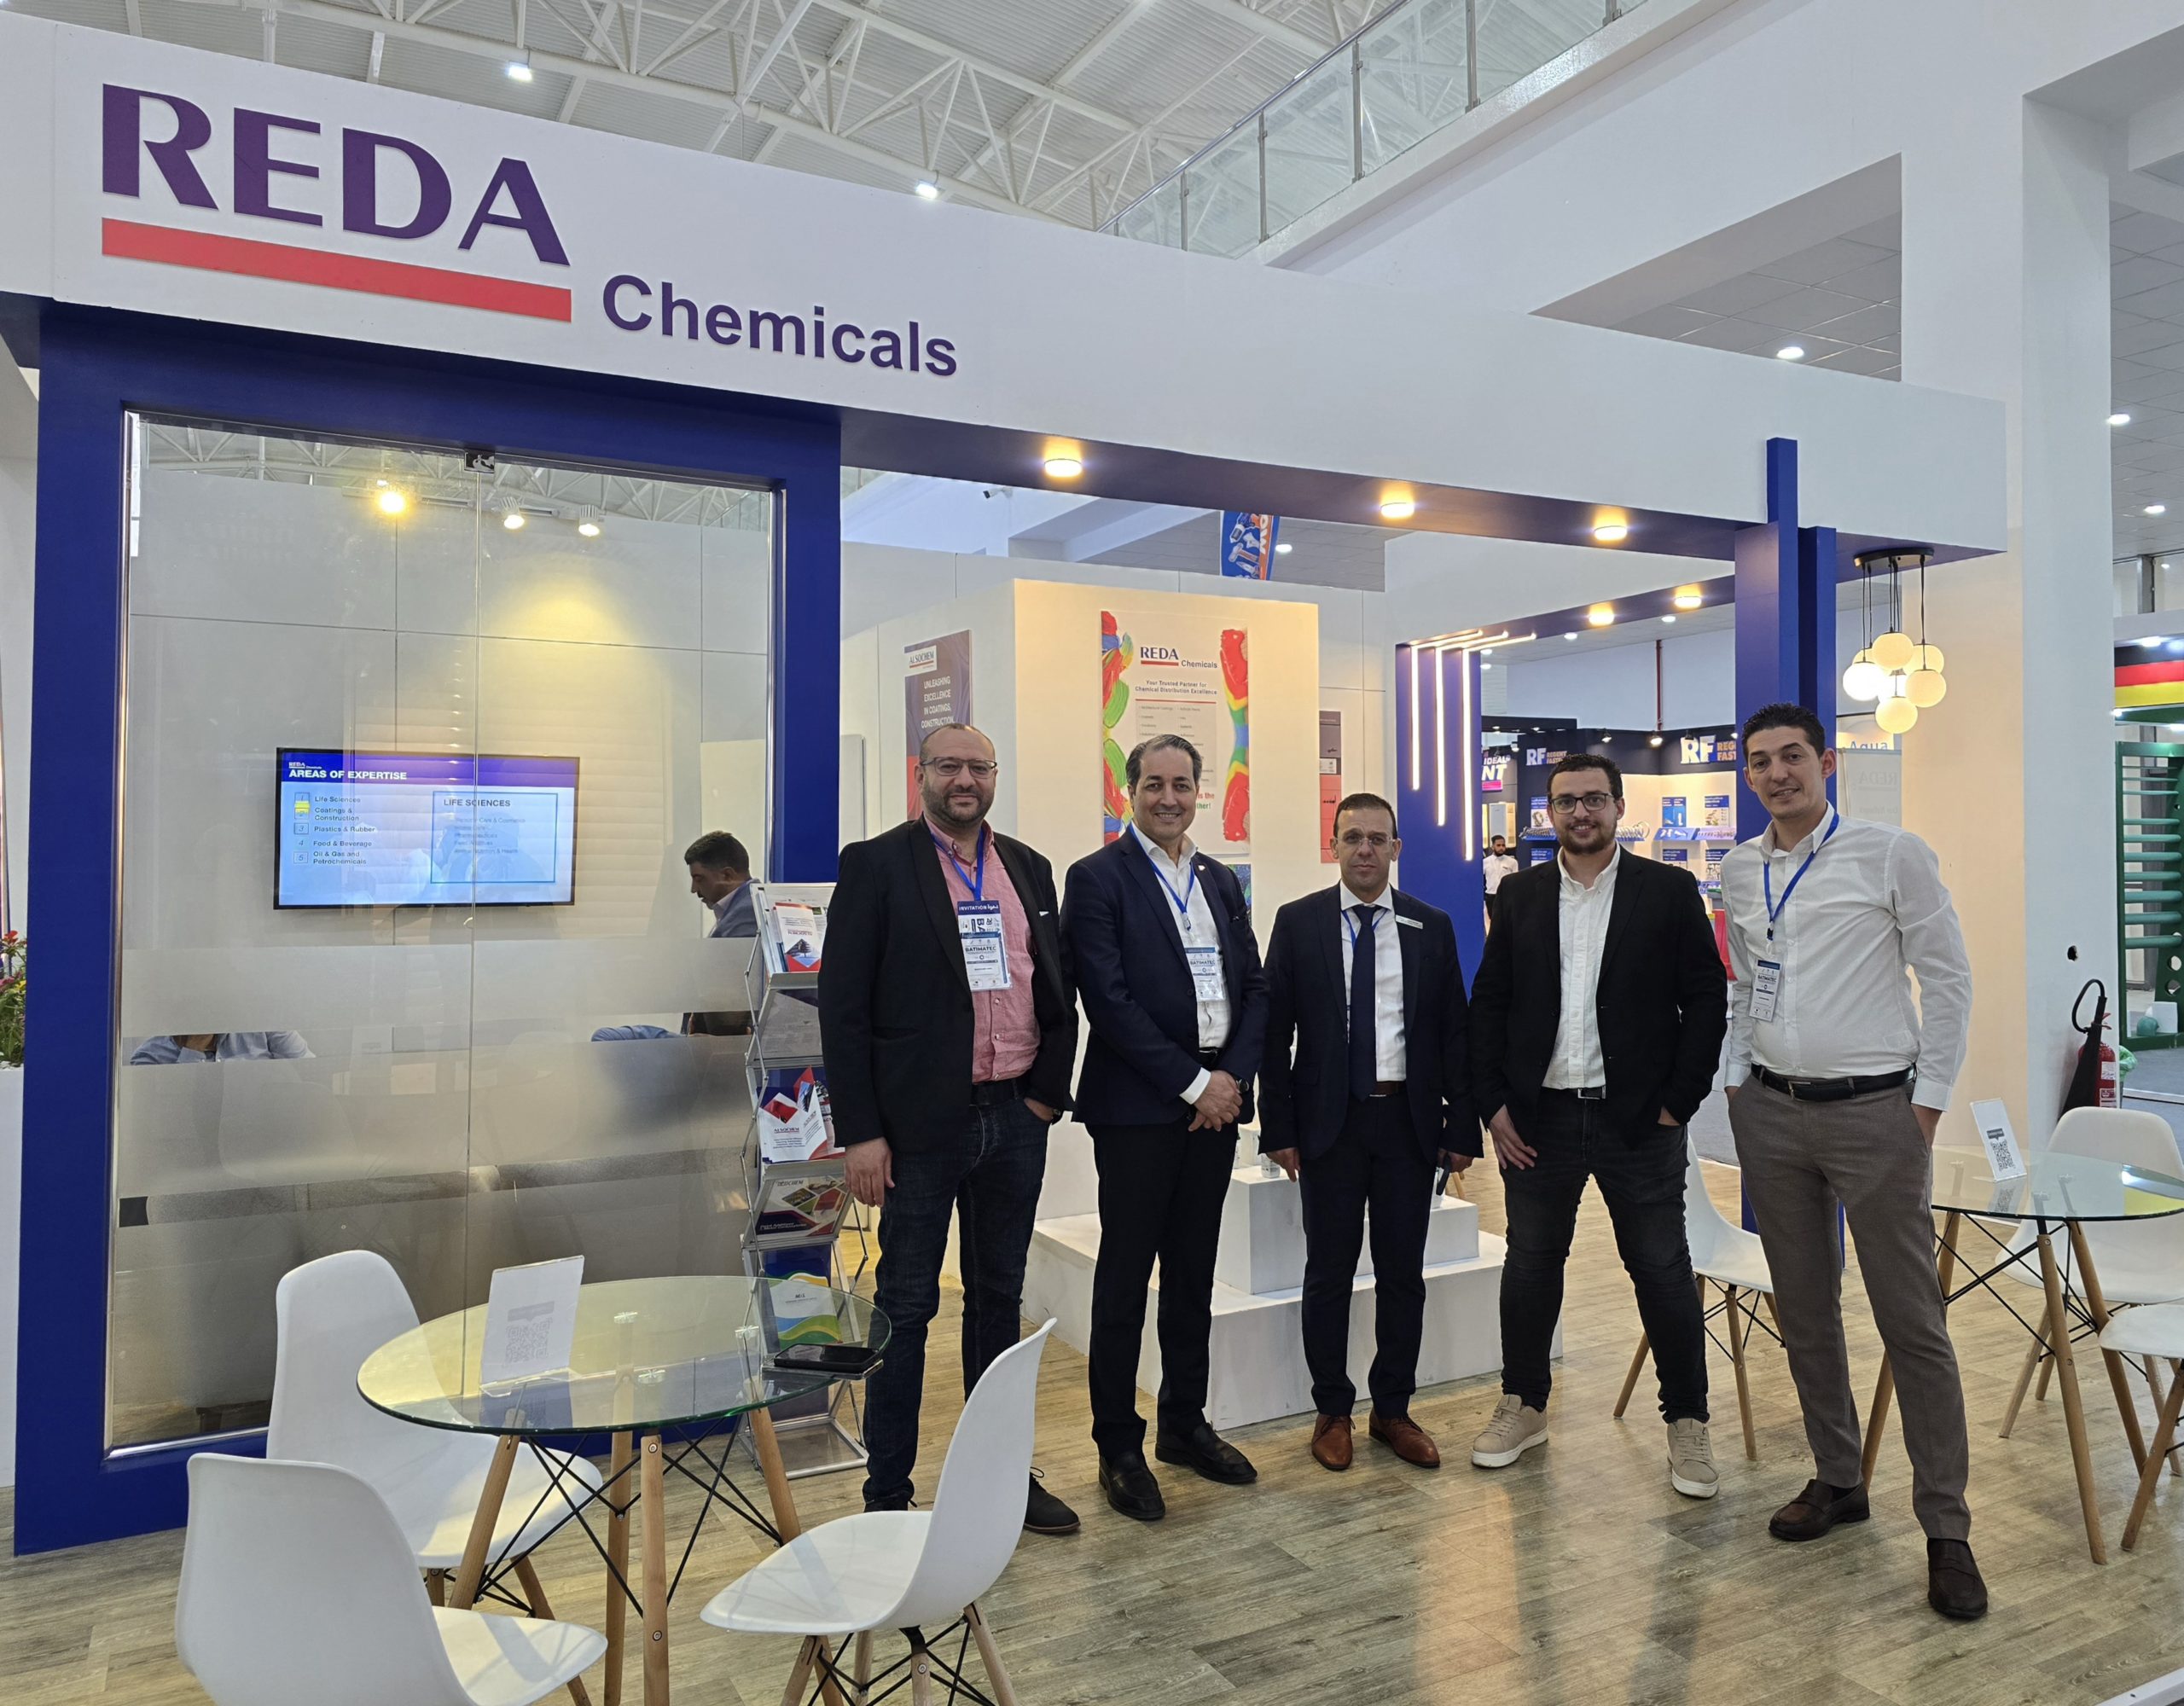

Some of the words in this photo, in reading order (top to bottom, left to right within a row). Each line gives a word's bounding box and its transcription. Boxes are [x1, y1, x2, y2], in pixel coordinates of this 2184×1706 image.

[102, 84, 571, 267] REDA
[602, 274, 958, 377] Chemicals
[1140, 646, 1180, 660] REDA
[1181, 659, 1218, 669] Chemicals
[924, 676, 950, 689] UNLEASHING
[924, 689, 951, 701] EXCELLENCE
[1680, 734, 1716, 764] RF
[1717, 740, 1736, 751] REG
[1525, 747, 1547, 766] RF
[288, 769, 327, 778] AREAS
[329, 770, 346, 779] OF
[347, 771, 407, 780] EXPERTISE
